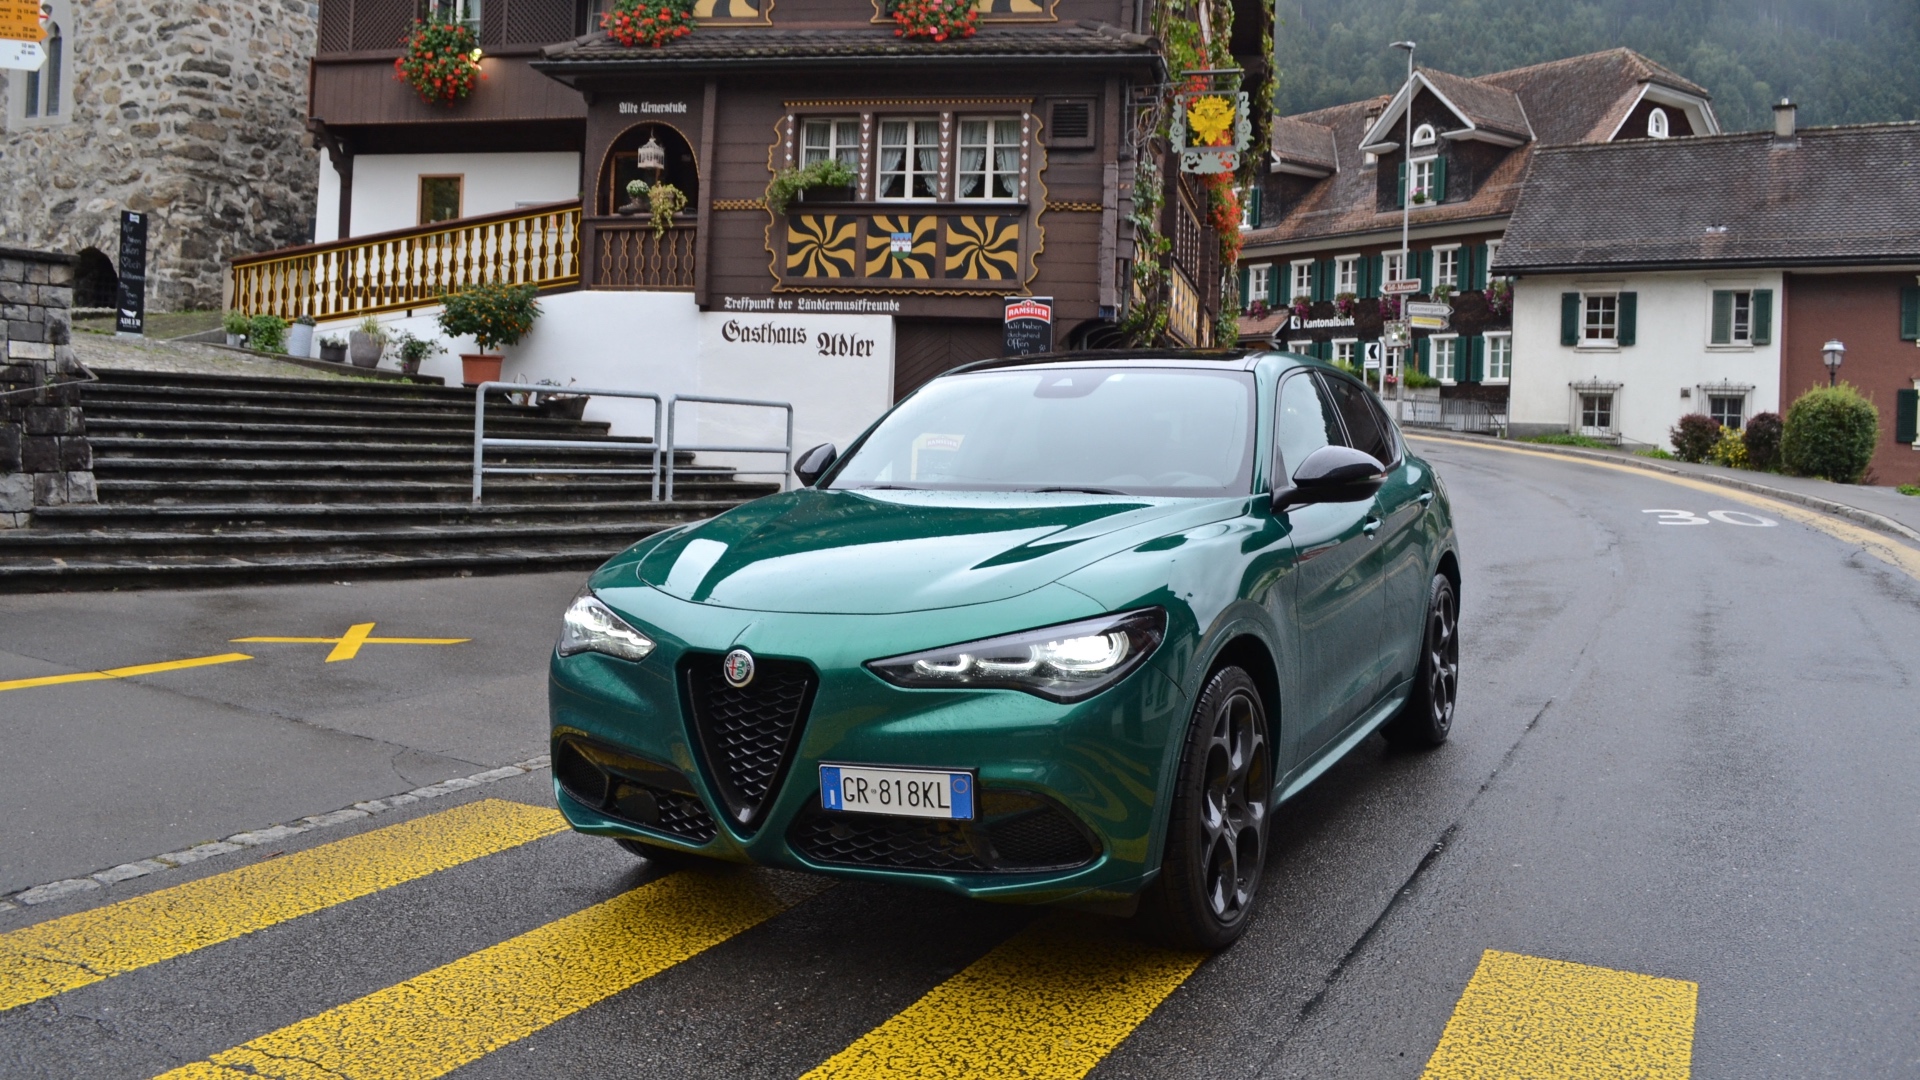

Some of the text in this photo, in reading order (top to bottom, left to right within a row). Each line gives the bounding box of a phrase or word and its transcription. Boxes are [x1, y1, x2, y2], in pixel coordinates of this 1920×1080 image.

[619, 101, 687, 114] Alte Urnerstube
[724, 296, 900, 312] Treffpunkt der Ländlermusikfreunde
[1008, 307, 1048, 317] RAMSEIER
[120, 317, 141, 326] ADLER
[1007, 322, 1020, 330] Wir
[1303, 316, 1355, 328] Kantonalbank
[721, 318, 875, 358] Gasthaus Adler
[1007, 338, 1029, 349] Offen
[1641, 509, 1779, 527] 30
